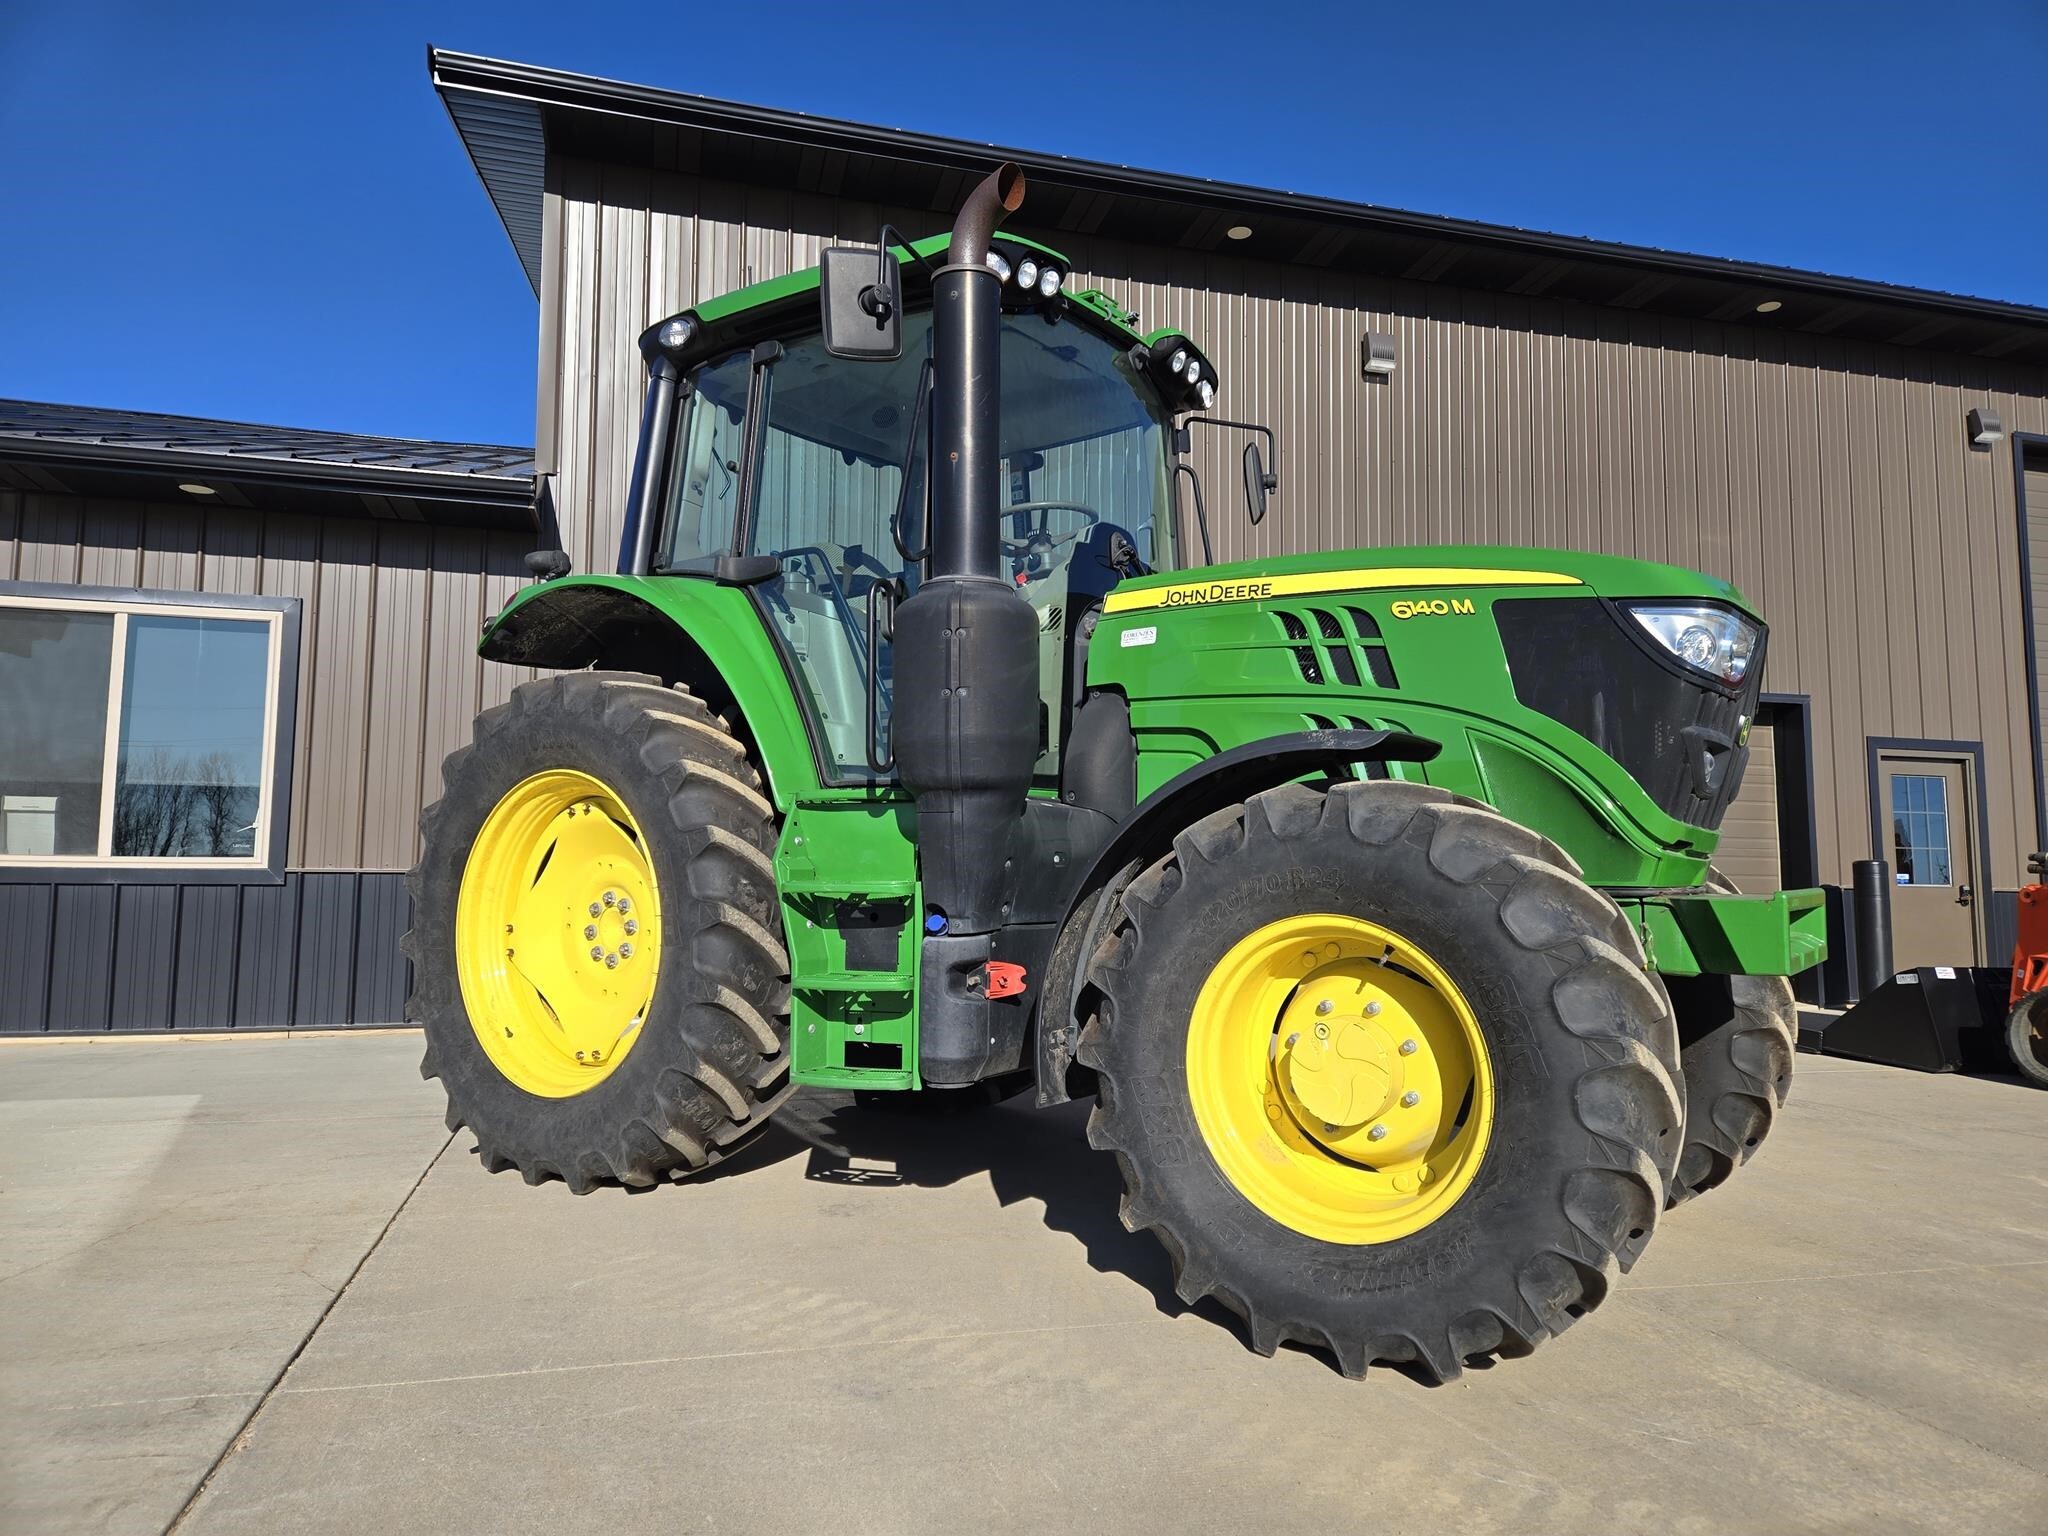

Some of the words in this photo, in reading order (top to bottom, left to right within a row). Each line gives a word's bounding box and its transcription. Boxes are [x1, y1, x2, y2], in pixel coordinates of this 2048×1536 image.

[1160, 589, 1207, 605] JOHN
[1210, 583, 1272, 600] DEERE
[1391, 599, 1449, 620] 6140
[1450, 598, 1476, 615] M
